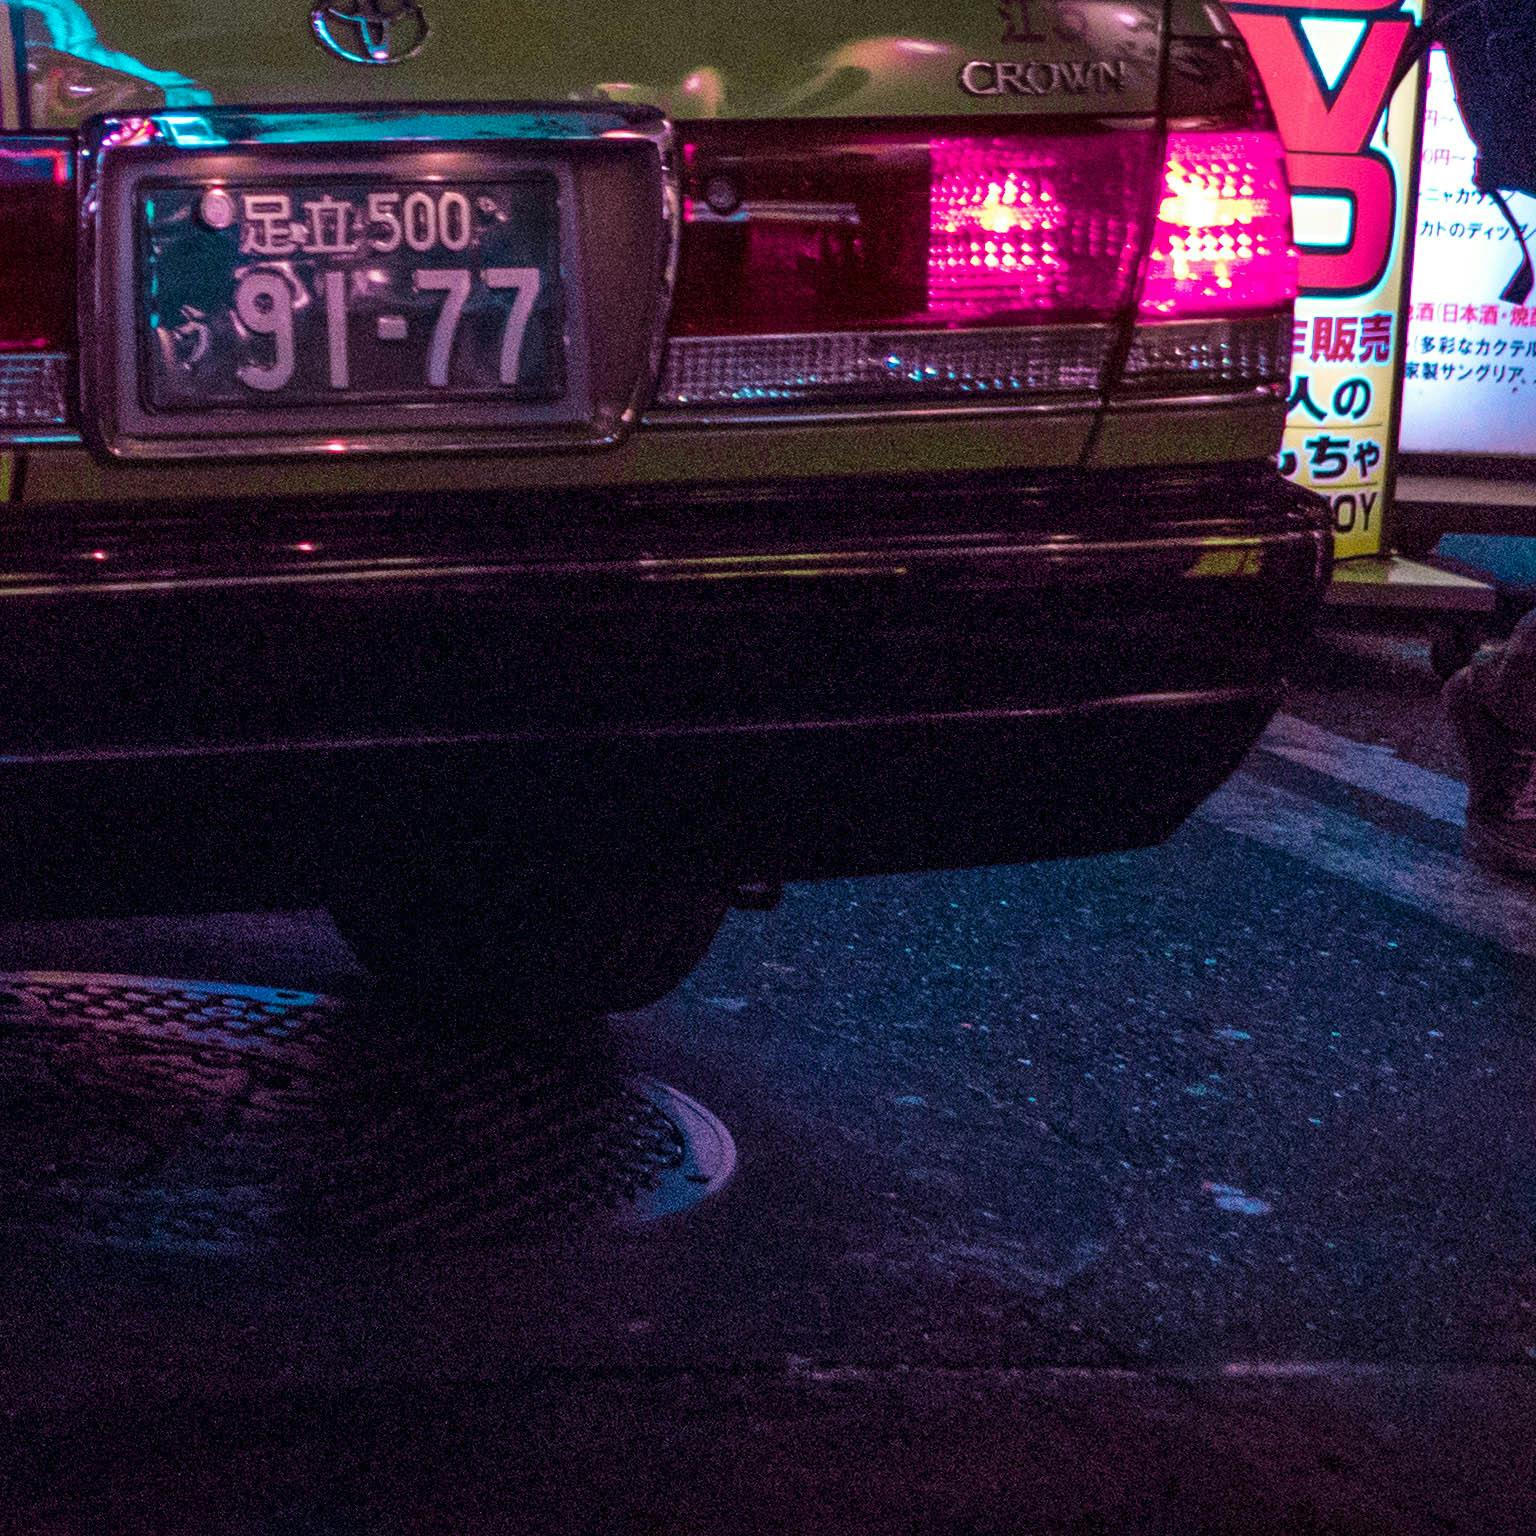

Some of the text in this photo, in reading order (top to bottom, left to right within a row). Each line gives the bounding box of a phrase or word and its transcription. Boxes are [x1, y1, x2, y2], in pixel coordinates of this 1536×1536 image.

[960, 59, 1126, 97] CROWN
[240, 191, 472, 254] 足立 500
[236, 266, 541, 392] 91-77
[1329, 492, 1377, 533] OY
